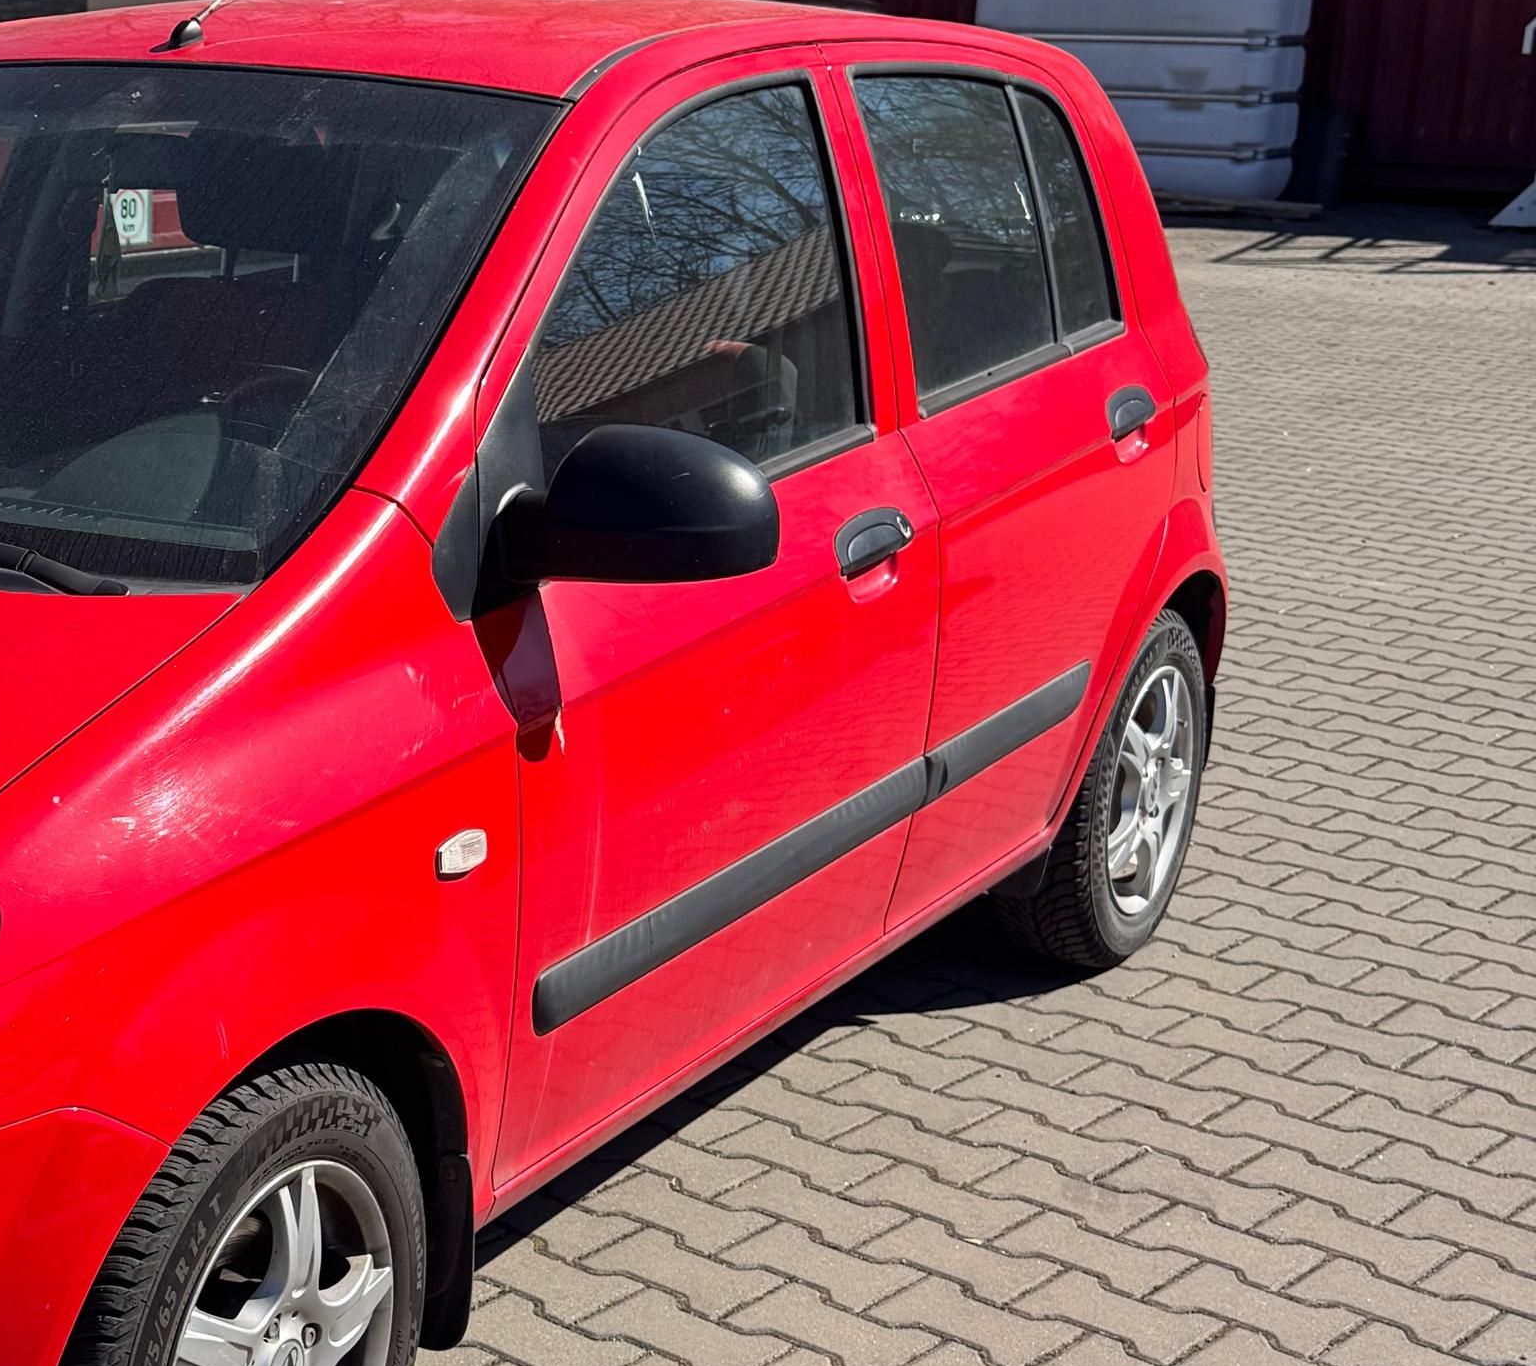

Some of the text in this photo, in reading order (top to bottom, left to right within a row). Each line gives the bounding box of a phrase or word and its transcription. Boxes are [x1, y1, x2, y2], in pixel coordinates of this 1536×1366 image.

[120, 198, 137, 219] 80
[122, 223, 135, 234] km
[175, 1256, 190, 1285] R
[209, 1192, 221, 1219] T
